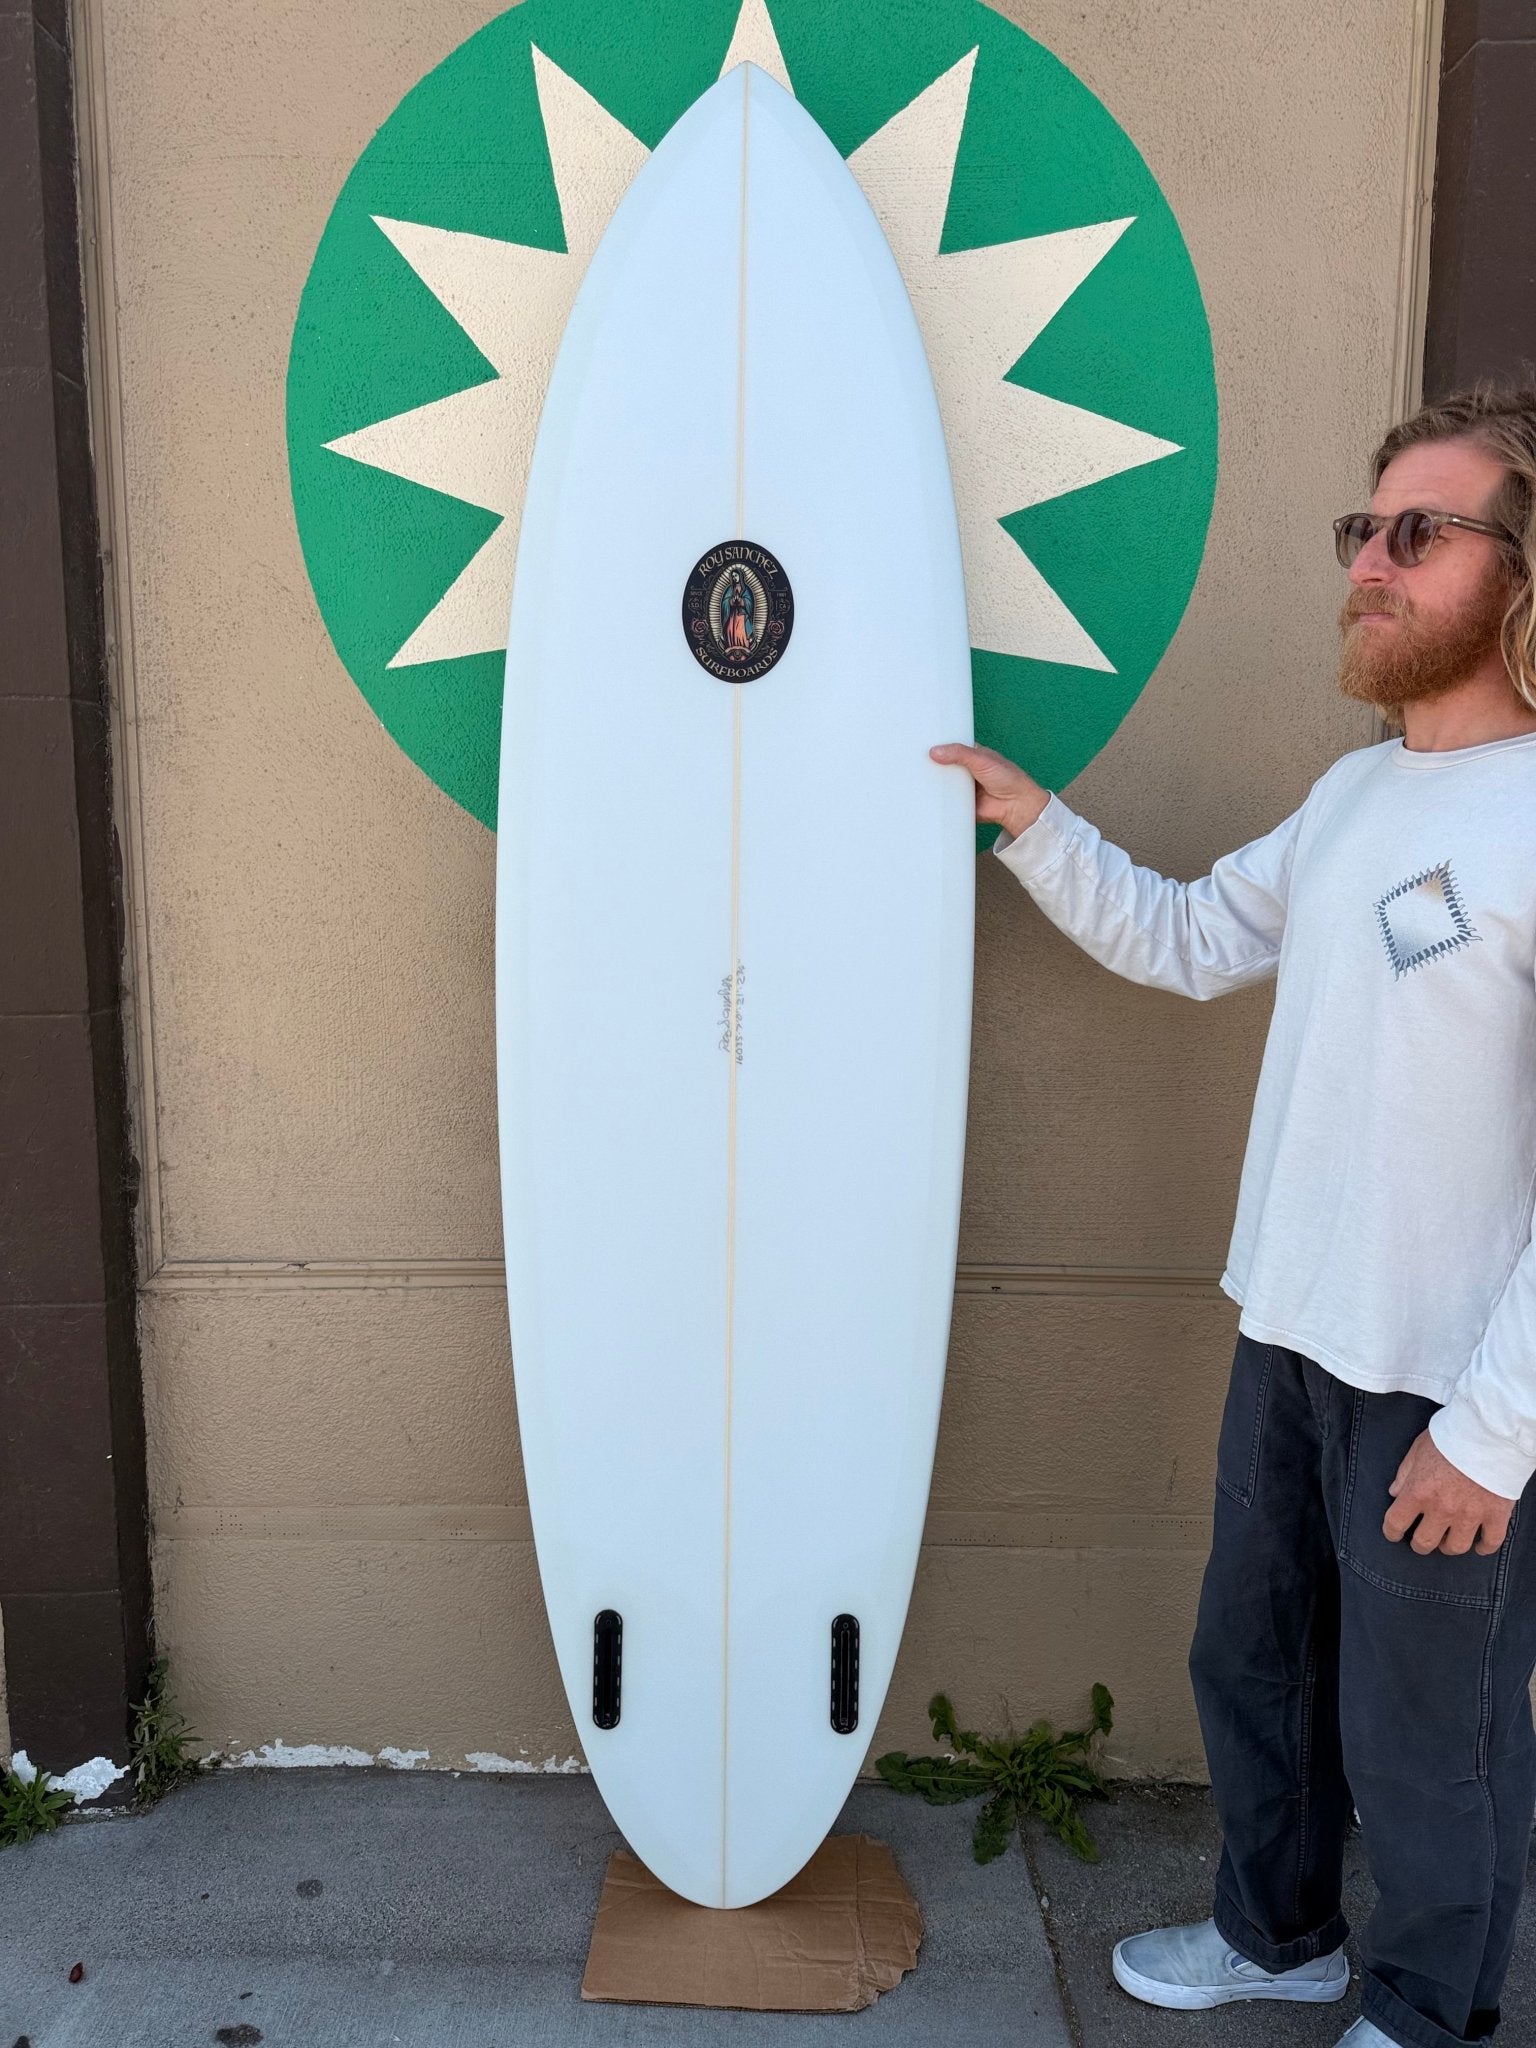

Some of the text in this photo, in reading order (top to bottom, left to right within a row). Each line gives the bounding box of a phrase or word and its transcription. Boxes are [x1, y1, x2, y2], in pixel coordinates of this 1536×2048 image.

[698, 546, 779, 580] ROY SANCHEZ
[695, 646, 778, 678] SURFBOARDS
